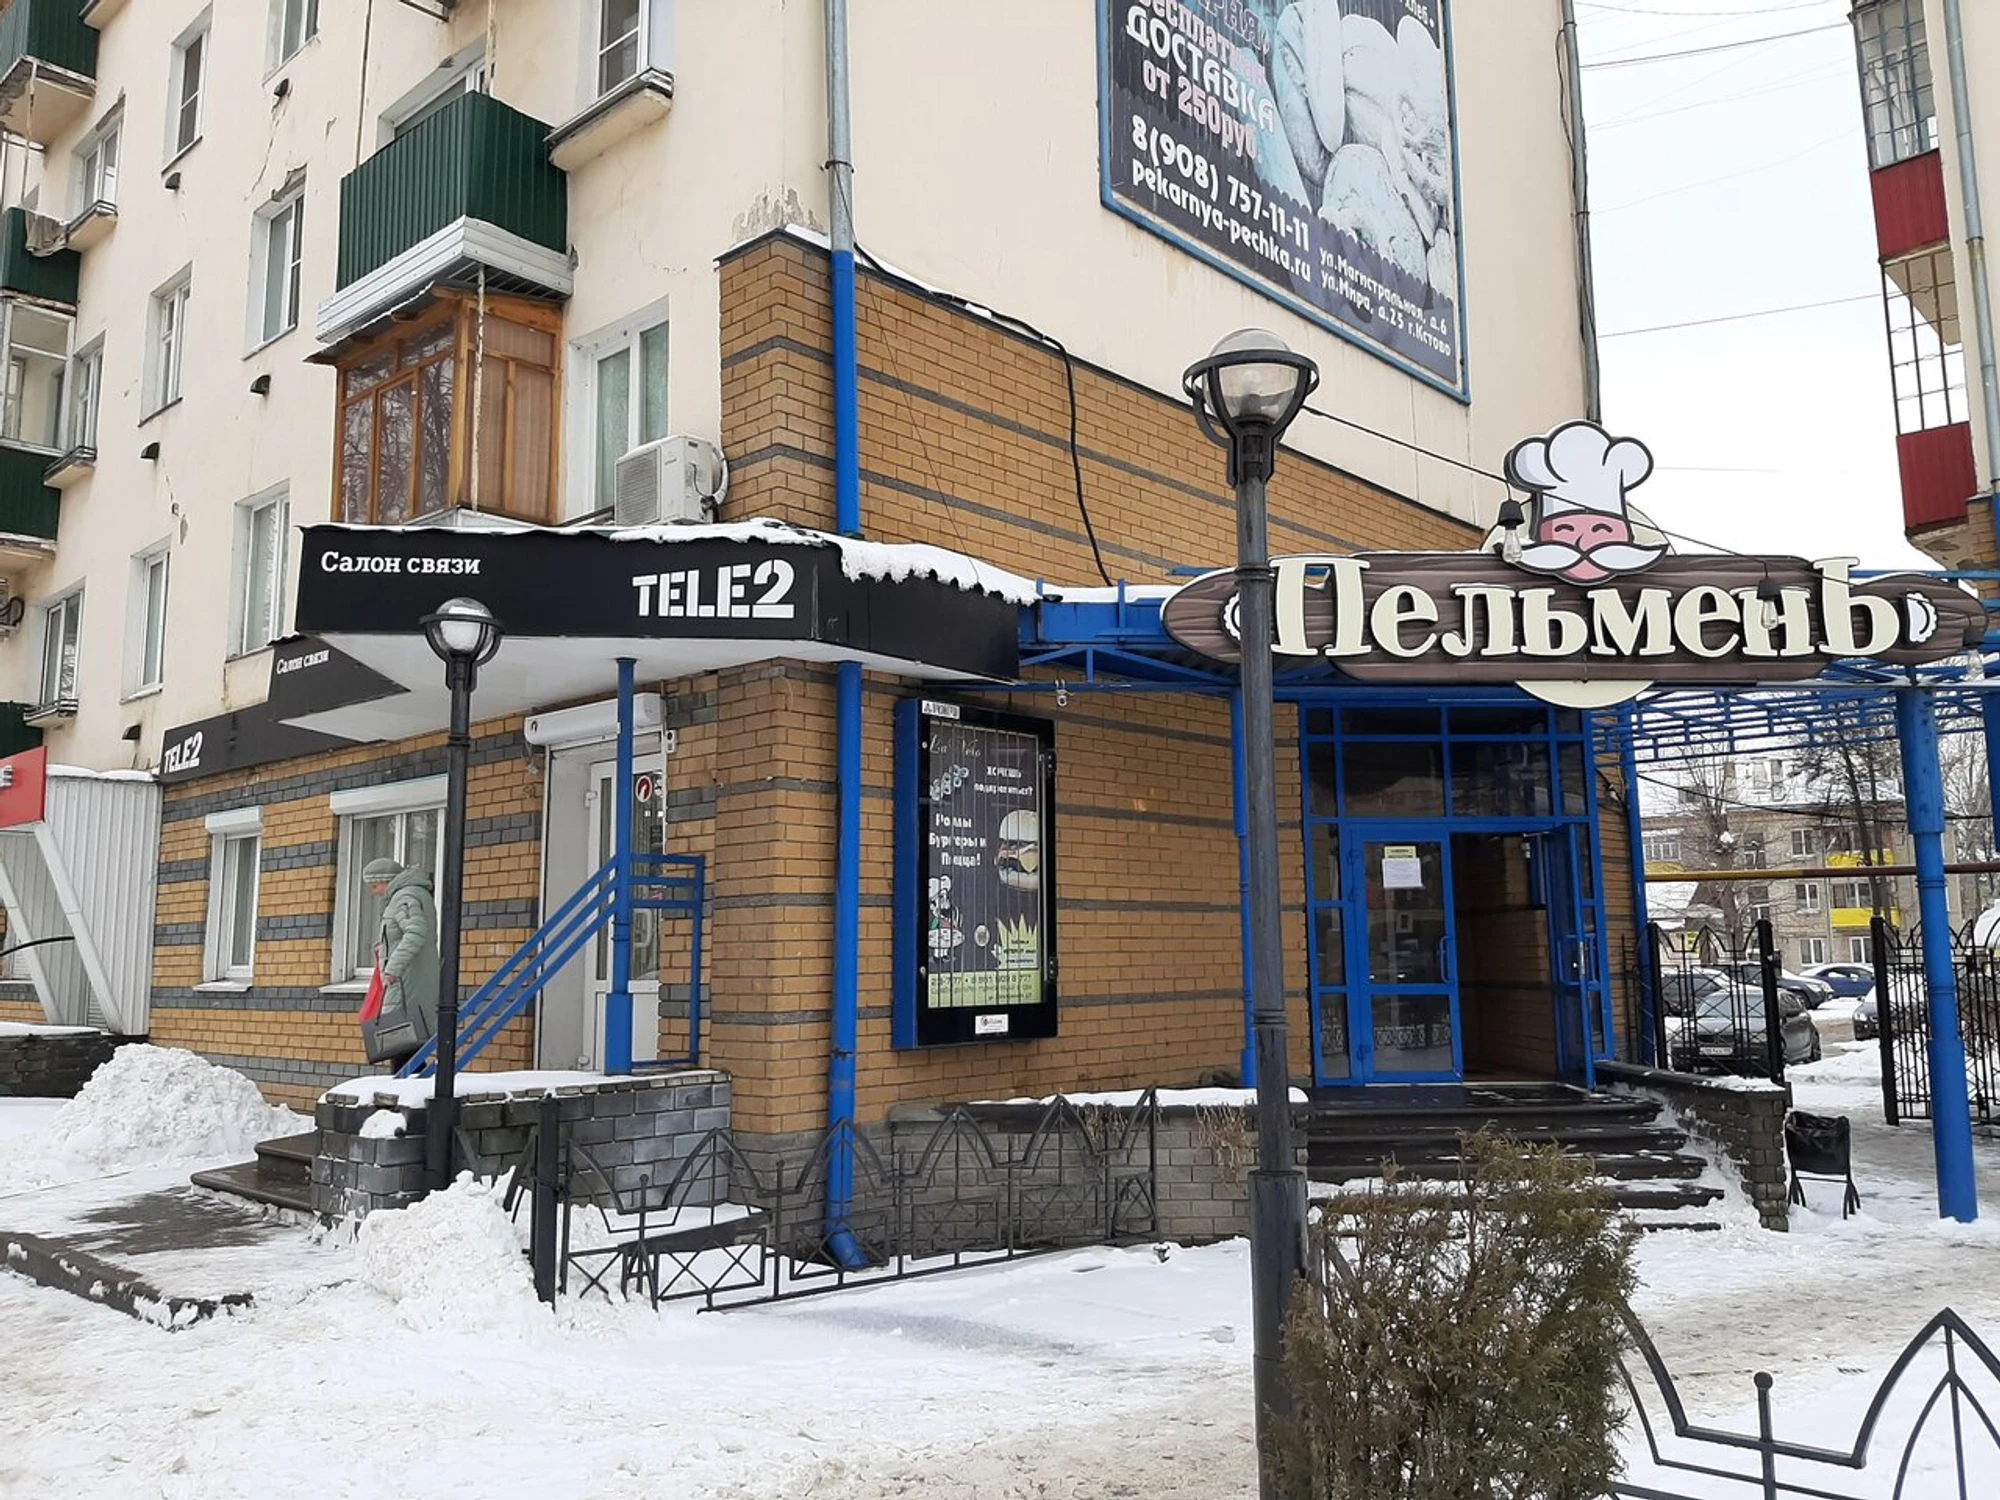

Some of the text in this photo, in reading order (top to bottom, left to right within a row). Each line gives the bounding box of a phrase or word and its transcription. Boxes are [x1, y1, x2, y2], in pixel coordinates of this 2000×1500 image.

[1126, 5, 1274, 133] ДОСТАВКА
[1132, 114, 1310, 252] 8(908) 757-11-11
[1132, 157, 1312, 283] pekarnya-pechka.ru
[1407, 321, 1452, 357] г.Кстово
[320, 550, 481, 575] Салон связи
[632, 558, 796, 620] TELE2
[163, 731, 203, 774] TELE2
